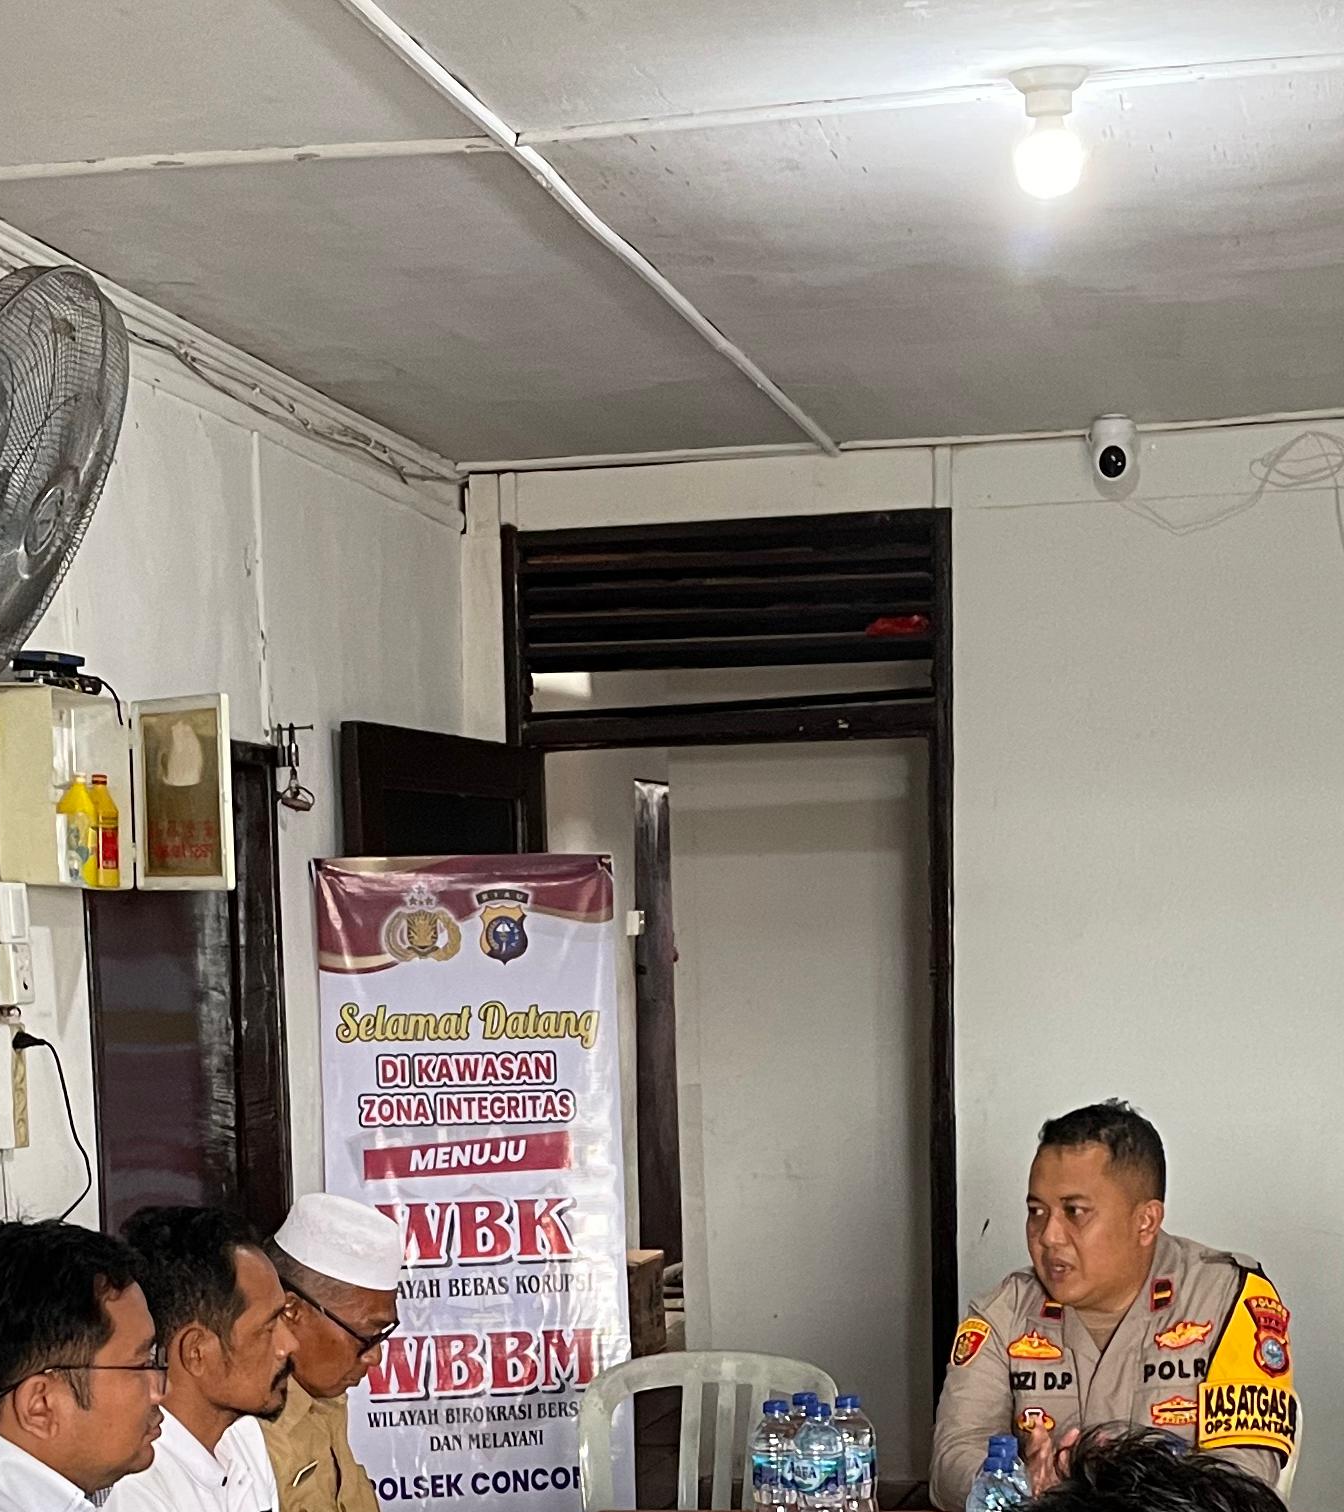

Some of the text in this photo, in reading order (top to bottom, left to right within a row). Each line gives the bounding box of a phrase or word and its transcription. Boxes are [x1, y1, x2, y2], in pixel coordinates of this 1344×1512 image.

[336, 1000, 601, 1049] Selamat Datang
[378, 1053, 554, 1085] DI KAWASAN
[361, 1092, 574, 1126] ZONA INTEGRITAS
[409, 1139, 527, 1172] MENUJU
[375, 1198, 575, 1264] WBK
[448, 1276, 510, 1298] BEBAS
[516, 1272, 594, 1295] KORUPSI
[366, 1328, 595, 1398] WBBM
[367, 1408, 439, 1428] WILAYAH
[445, 1403, 533, 1425] BIROKRASI
[1204, 1384, 1287, 1422] KASATGAS
[429, 1429, 544, 1452] DAN MELAYANI
[1204, 1418, 1233, 1435] OPS
